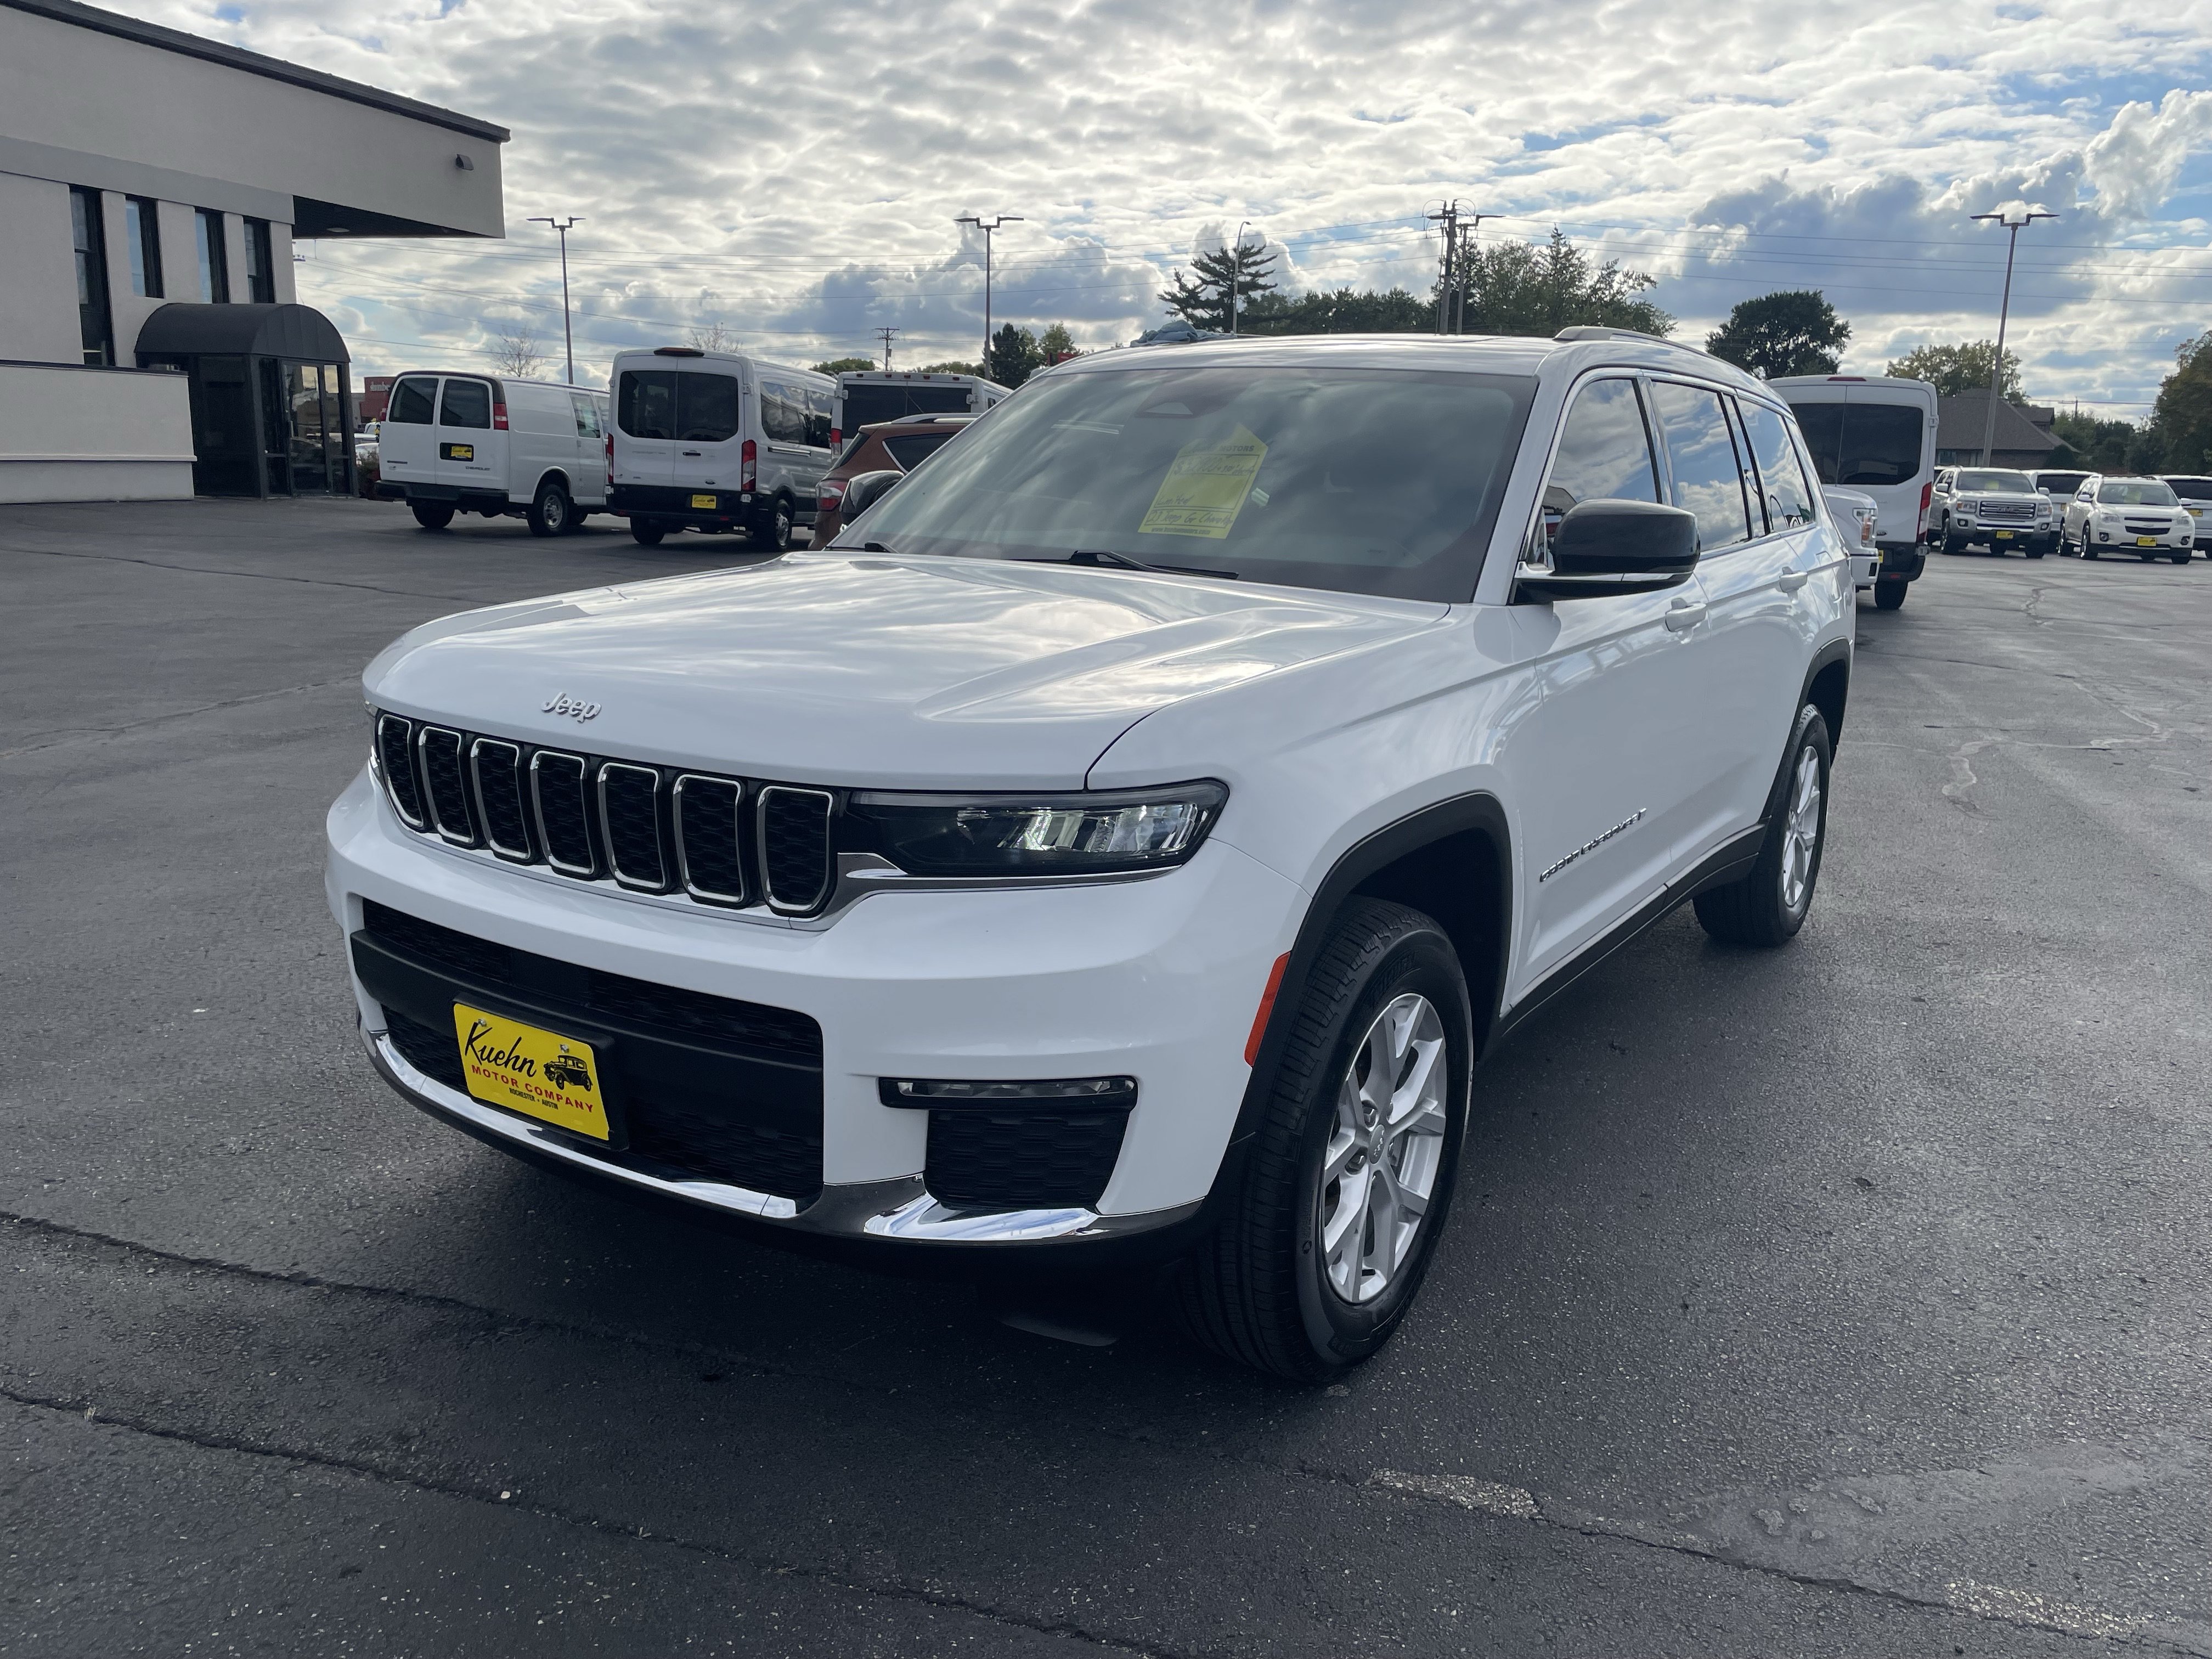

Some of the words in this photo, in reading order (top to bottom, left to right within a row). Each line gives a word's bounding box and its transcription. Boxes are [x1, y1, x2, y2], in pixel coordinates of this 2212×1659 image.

[540, 691, 602, 724] Jeep
[465, 1022, 537, 1077] Kuehn
[471, 1064, 520, 1088] MOTOR
[524, 1083, 594, 1113] COMPANY
[509, 1087, 536, 1102] ROCHESTER
[541, 1099, 559, 1110] AUSTIN
